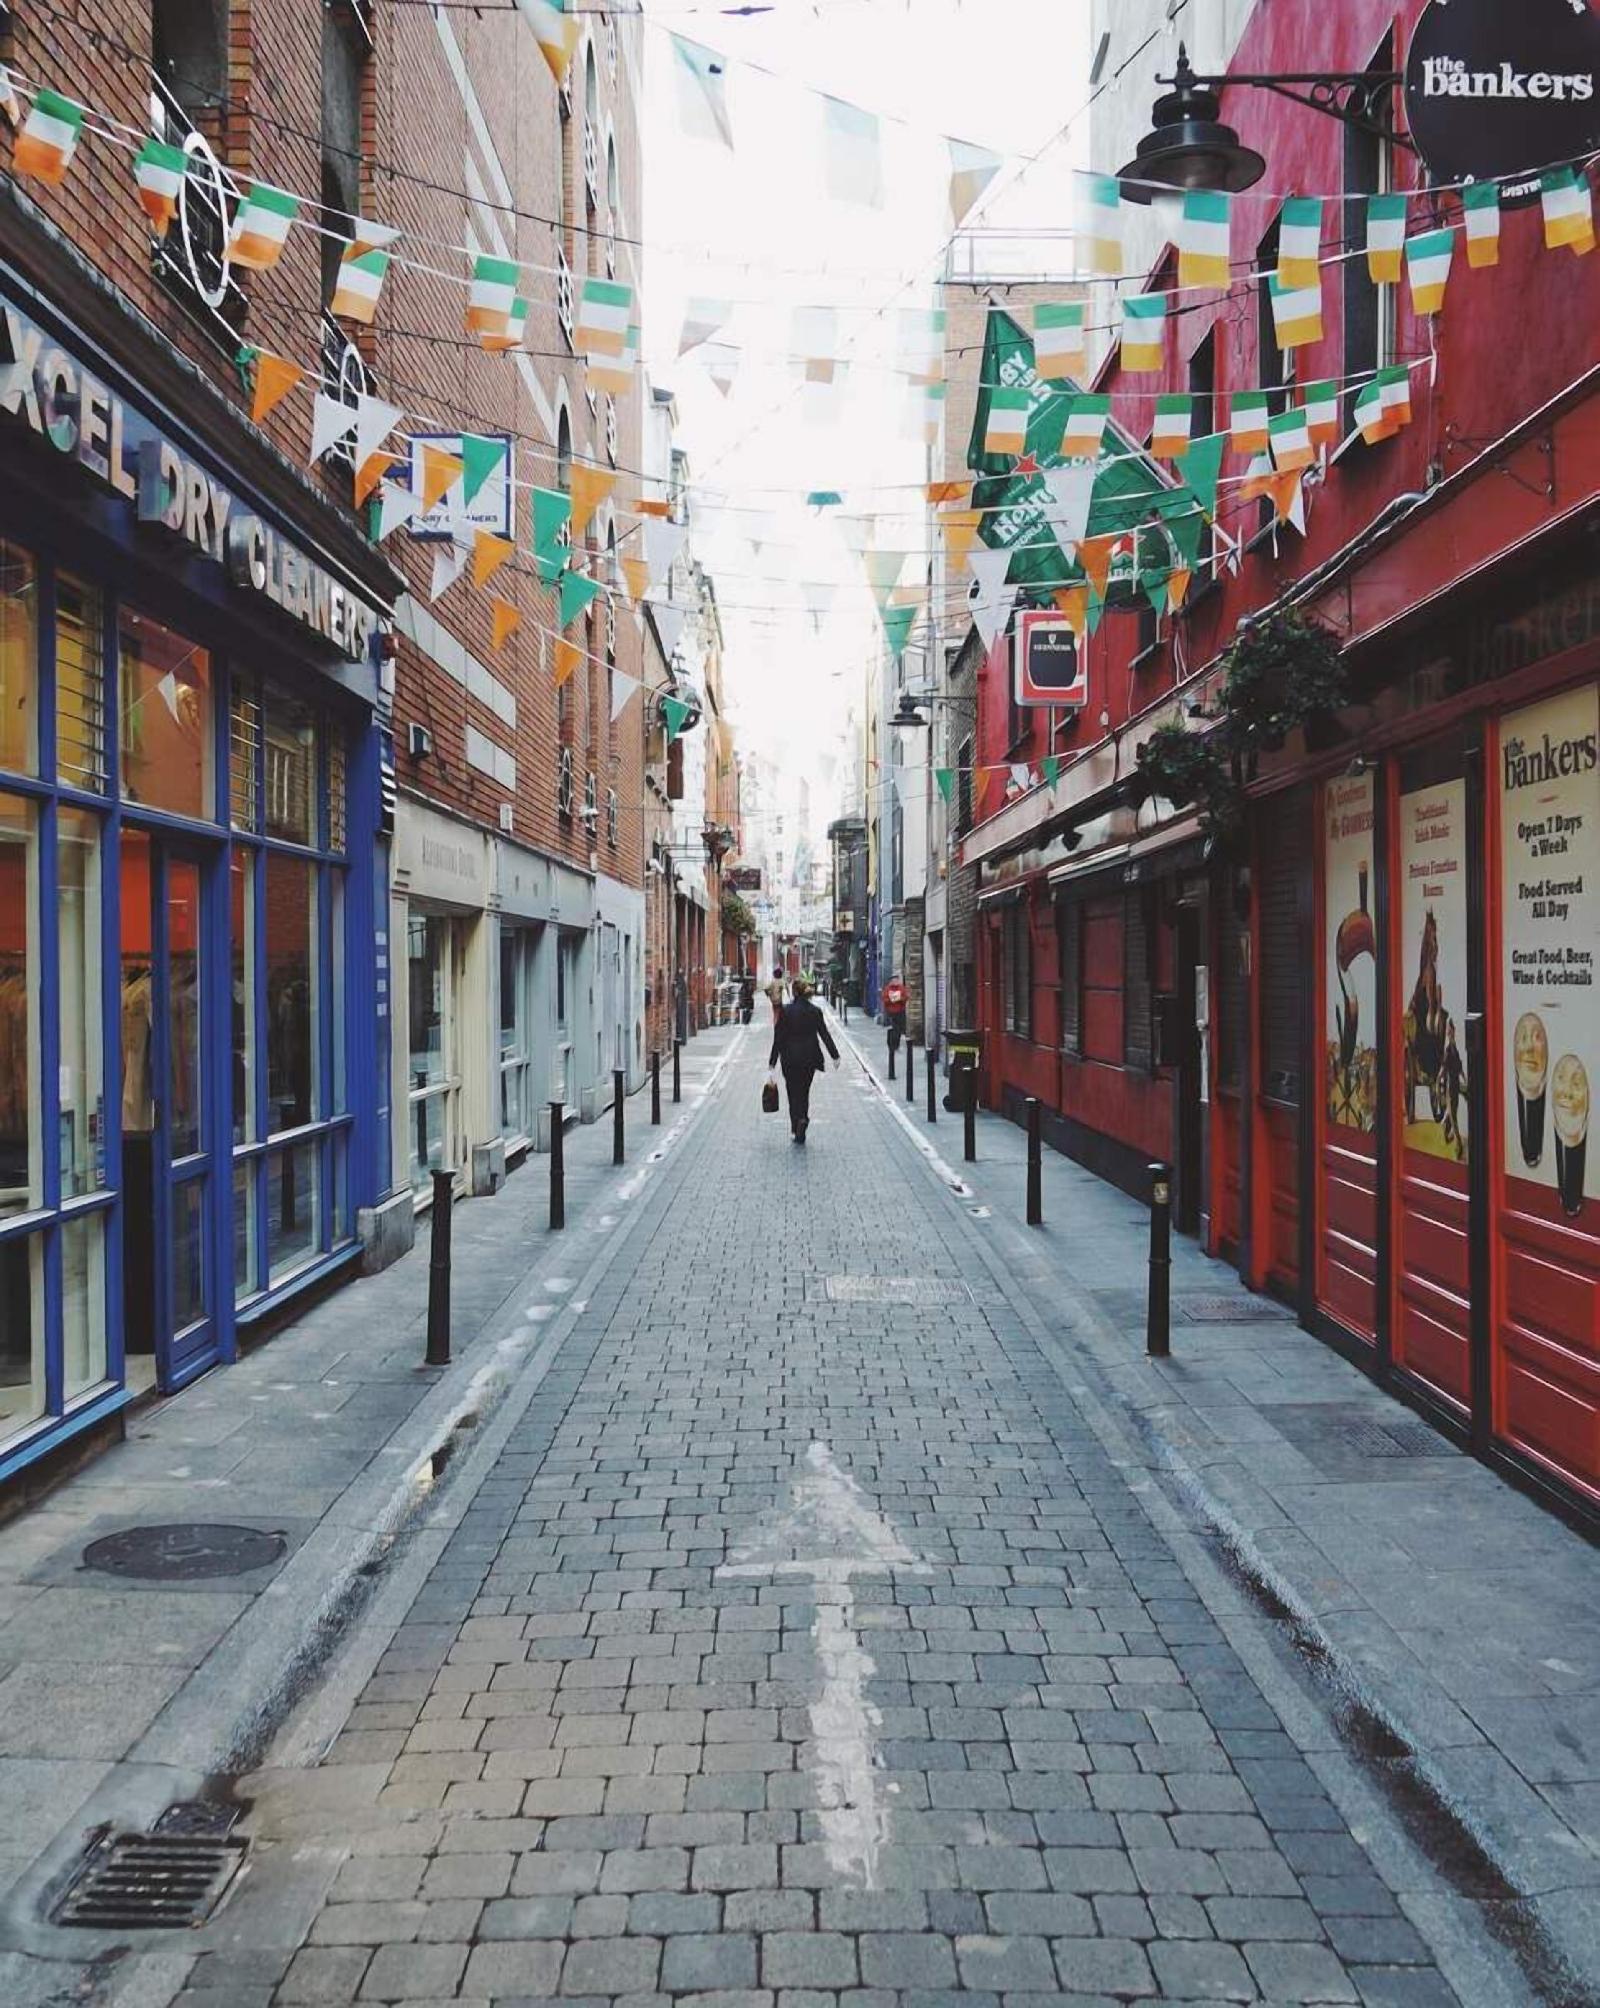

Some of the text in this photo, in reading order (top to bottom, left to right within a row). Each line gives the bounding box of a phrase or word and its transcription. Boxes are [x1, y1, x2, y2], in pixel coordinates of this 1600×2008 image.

[1434, 56, 1465, 73] the
[1421, 57, 1594, 101] bankers
[138, 440, 232, 561] DRY
[231, 514, 371, 664] CLEANERS
[1503, 733, 1597, 790] bankers
[1430, 822, 1450, 840] Music
[1518, 814, 1583, 842] Open 7 Days
[1531, 837, 1568, 857] a Week
[1518, 876, 1583, 900] Food Served
[1532, 900, 1569, 921] All Day
[1512, 949, 1537, 965] Great
[1566, 948, 1593, 968] Beer,
[1512, 969, 1593, 986] Wine & Cocktails
